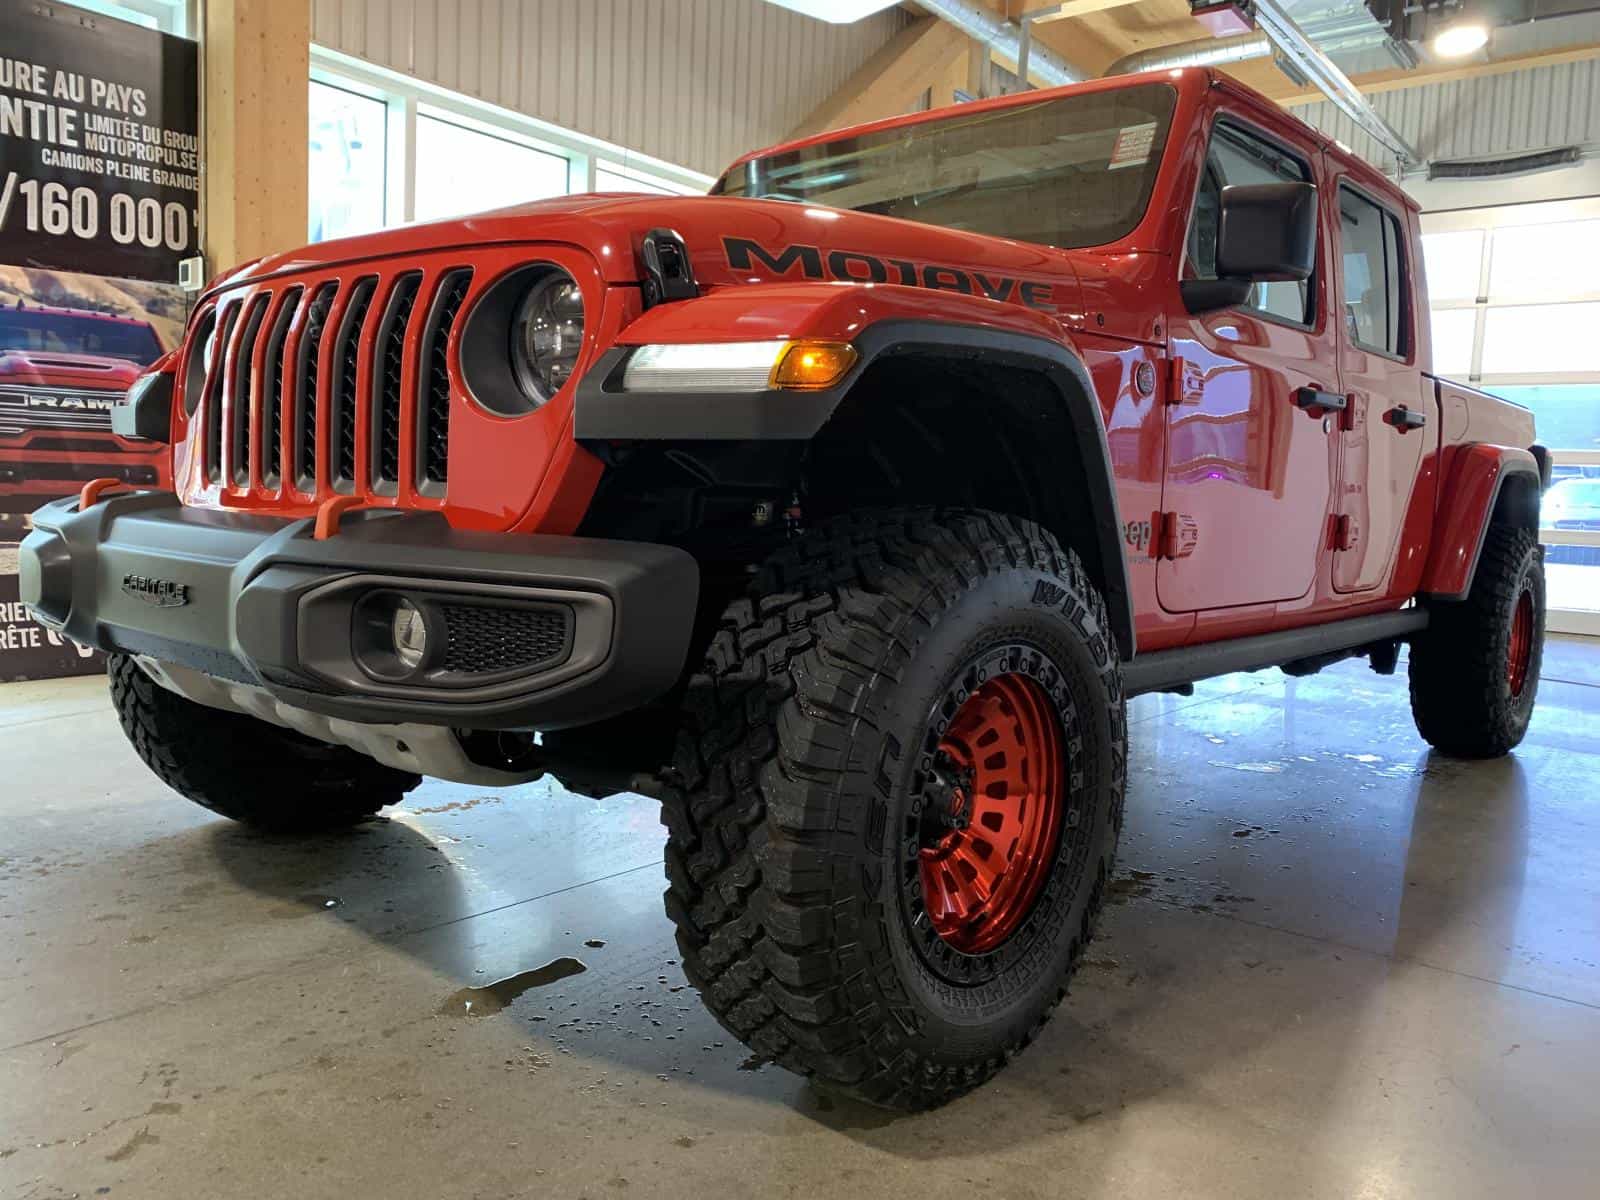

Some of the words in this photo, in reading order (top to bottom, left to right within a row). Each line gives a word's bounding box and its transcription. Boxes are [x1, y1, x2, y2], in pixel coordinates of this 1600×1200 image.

[0, 57, 48, 95] URE
[53, 70, 84, 102] AU
[91, 78, 146, 116] PAYS
[0, 95, 78, 147] NTIE
[84, 112, 140, 140] LIMITÉE
[142, 124, 160, 145] DU
[41, 148, 103, 174] CAMIONS
[106, 160, 151, 182] PLEINE
[110, 193, 188, 251] 000
[722, 237, 1058, 311] MOJAVE
[29, 395, 114, 410] RAM
